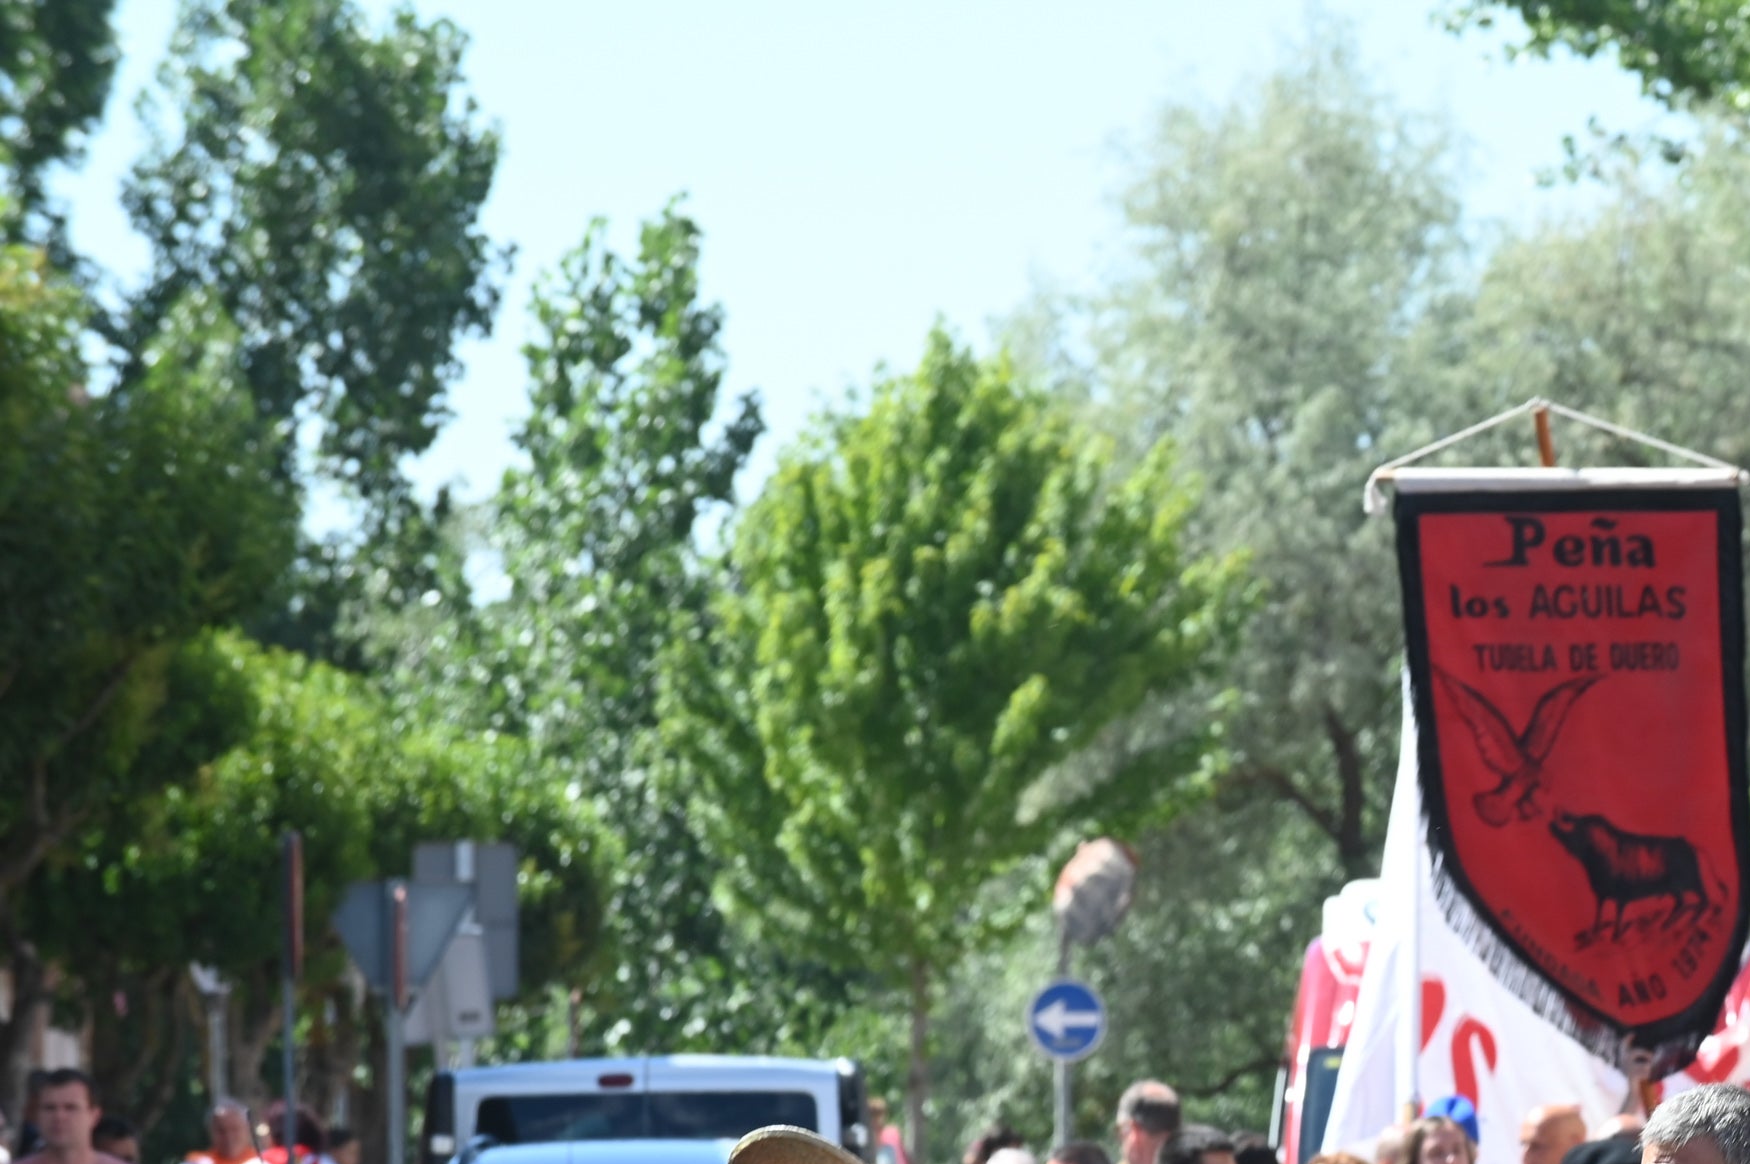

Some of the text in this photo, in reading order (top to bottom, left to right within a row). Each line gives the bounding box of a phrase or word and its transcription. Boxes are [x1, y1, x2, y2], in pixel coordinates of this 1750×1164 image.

[1481, 515, 1656, 568] Peña
[1449, 582, 1688, 620] los AGUILAS
[1472, 639, 1682, 672] TUDELA DE DUERO
[1618, 971, 1667, 1008] AÑO
